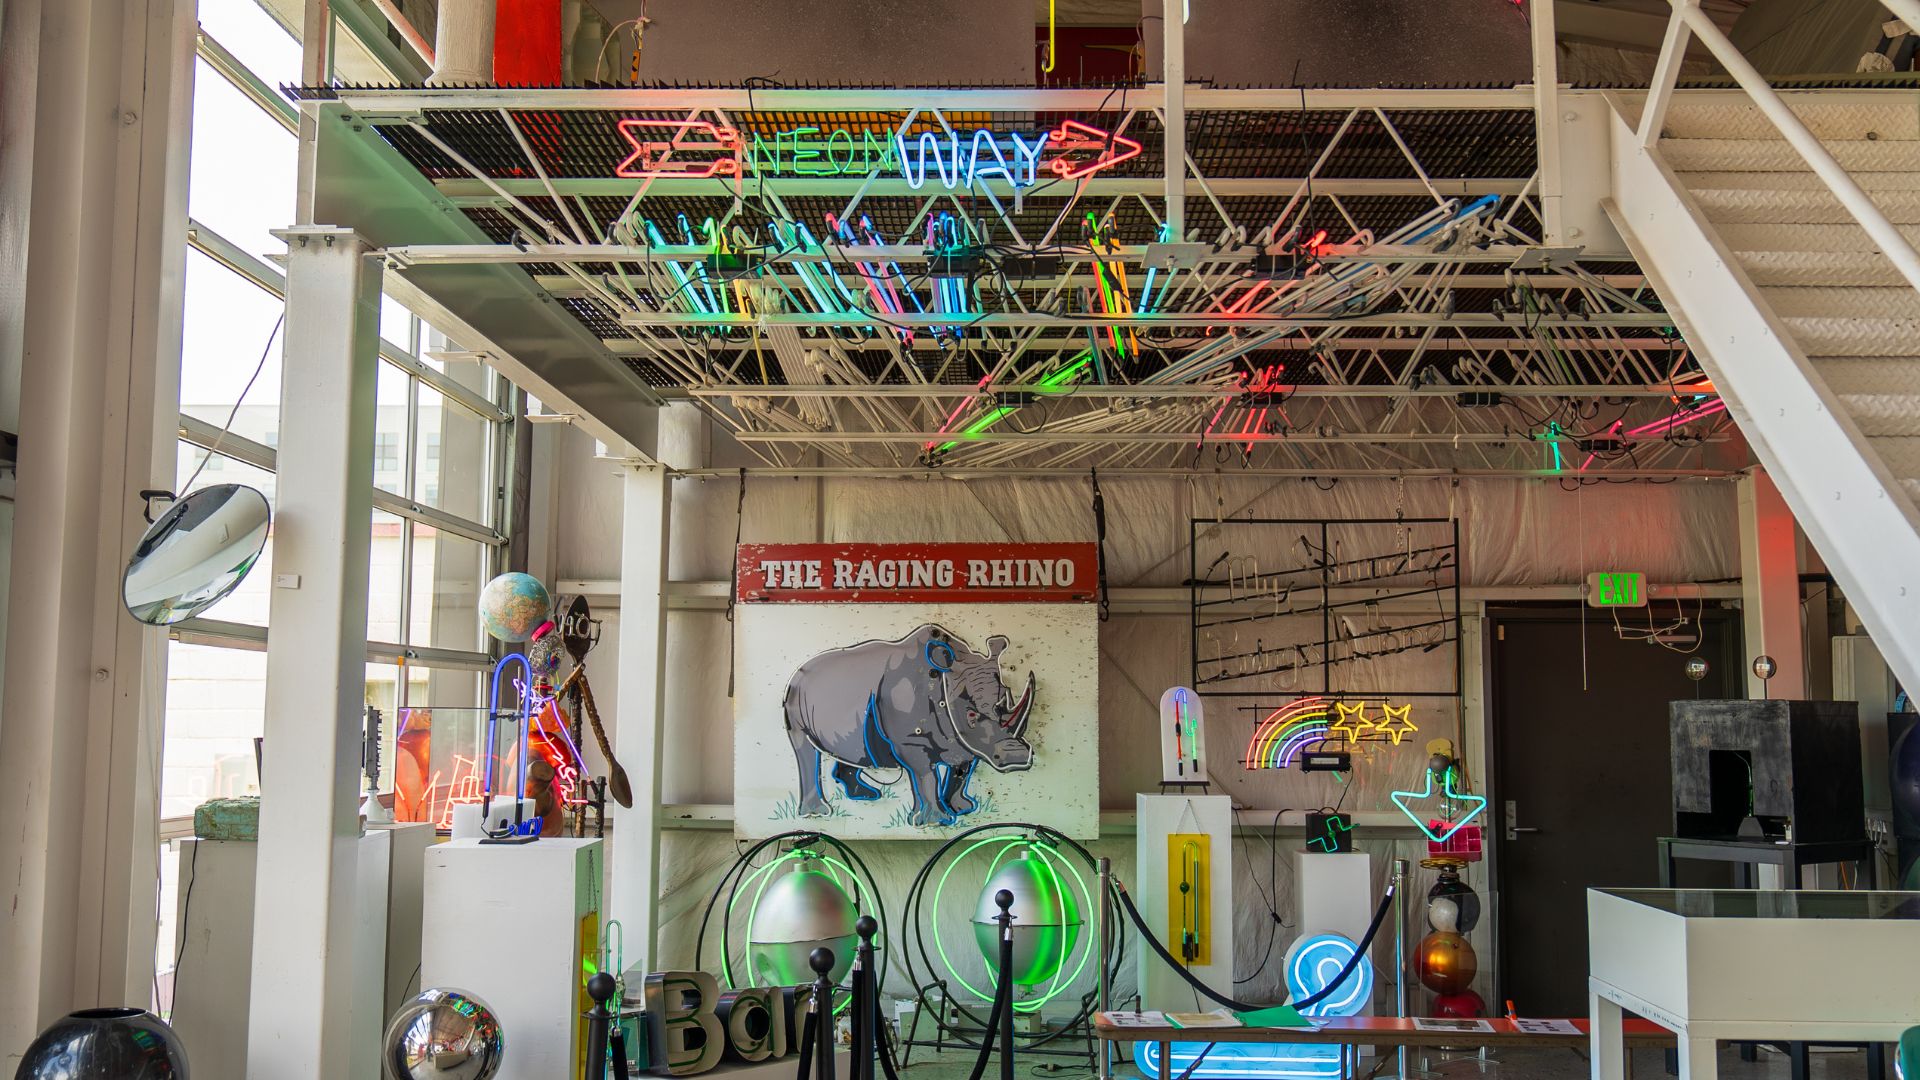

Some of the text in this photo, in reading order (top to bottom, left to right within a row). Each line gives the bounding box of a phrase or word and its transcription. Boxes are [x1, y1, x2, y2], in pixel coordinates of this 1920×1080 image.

[752, 127, 1049, 190] NEON WAY
[760, 558, 1076, 588] THE RAGING RHINO
[1599, 572, 1640, 605] EXIT
[645, 971, 813, 1076] Bar
